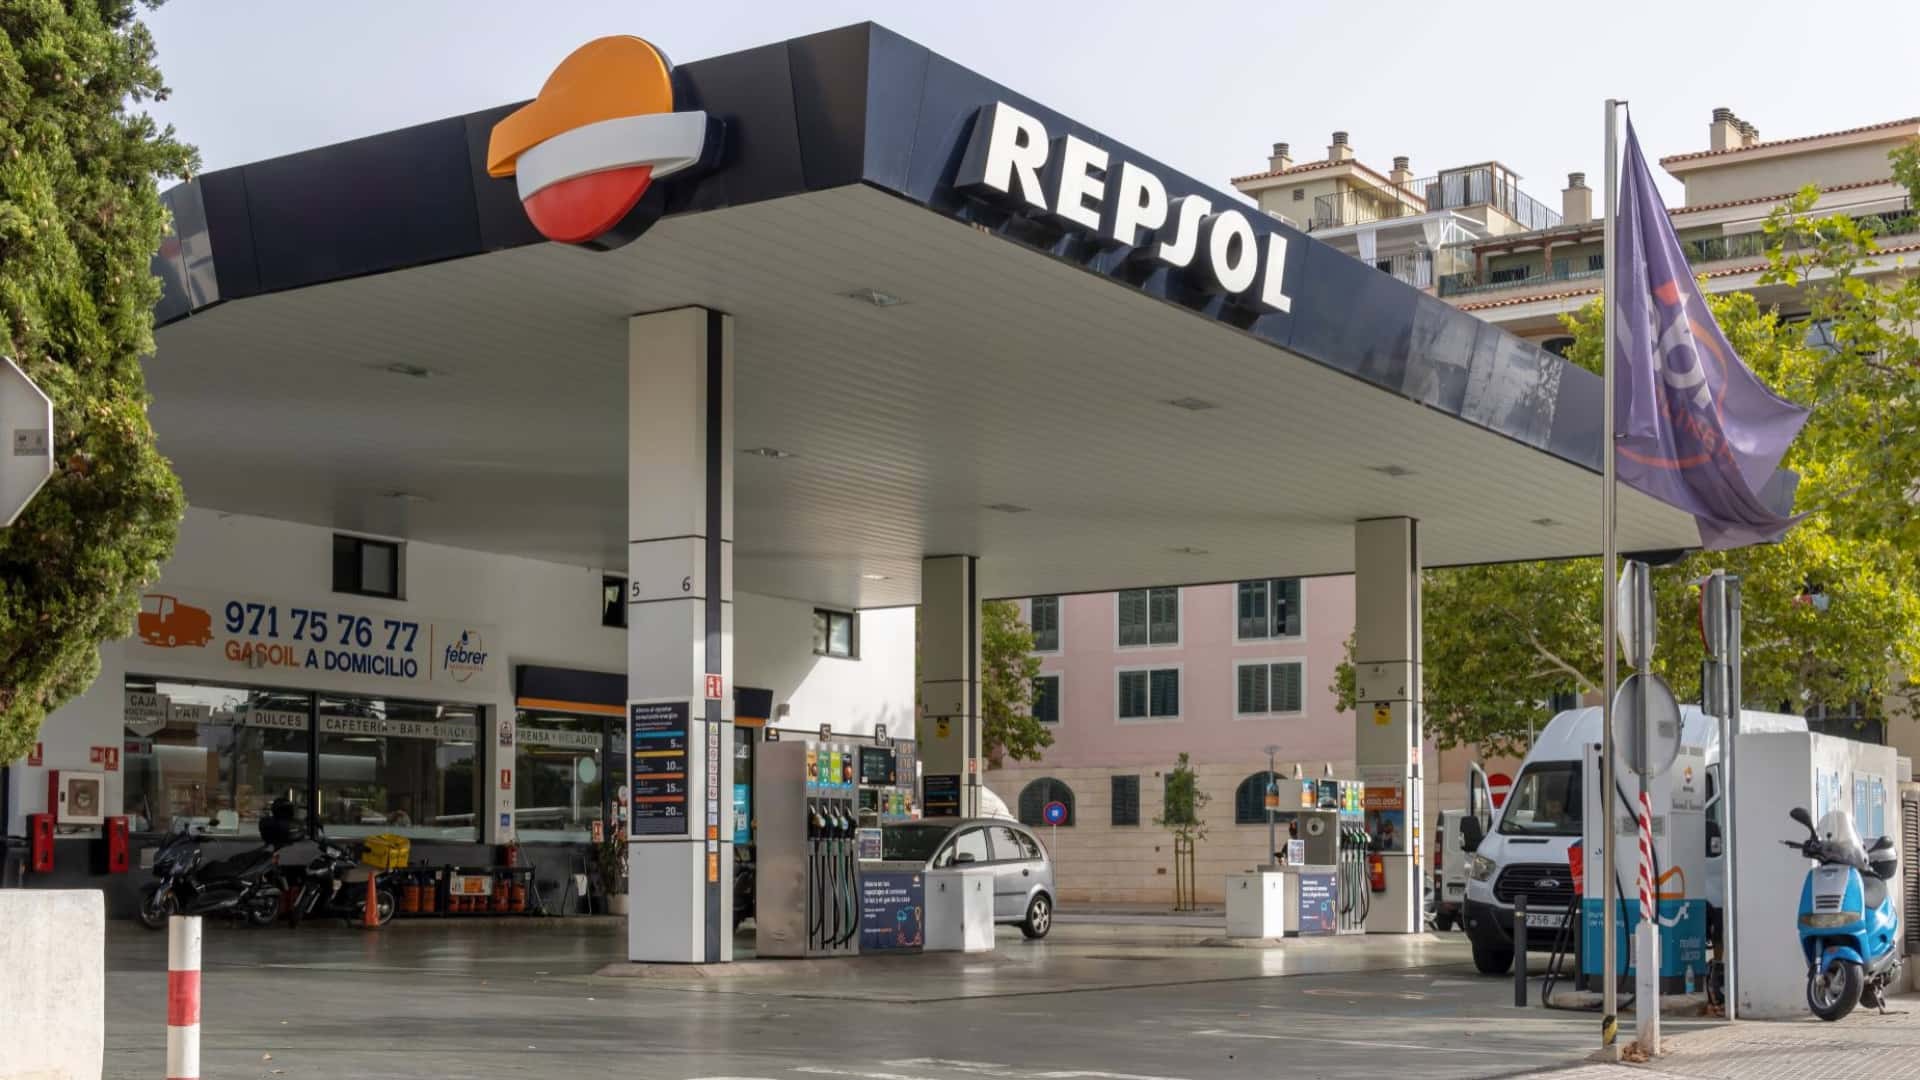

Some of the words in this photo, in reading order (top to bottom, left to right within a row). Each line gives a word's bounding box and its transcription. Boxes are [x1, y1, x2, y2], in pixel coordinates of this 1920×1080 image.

[984, 101, 1291, 313] REPSOL
[632, 582, 640, 597] 5
[682, 576, 691, 592] 6
[225, 601, 279, 638] 971
[291, 608, 328, 643] 75
[337, 614, 373, 648] 76
[384, 619, 419, 652] 77
[225, 640, 300, 667] GASOIL
[304, 648, 318, 669] A
[324, 650, 418, 678] DOMICILIO
[444, 644, 488, 670] febrer
[130, 695, 158, 707] CAJA
[175, 706, 200, 719] PAN
[255, 711, 303, 726] DULCES
[400, 723, 421, 735] BAR
[821, 725, 830, 740] 5
[877, 725, 886, 742] 6
[670, 739, 676, 748] 5
[666, 760, 676, 770] 10
[666, 783, 676, 793] 15
[665, 806, 676, 816] 20
